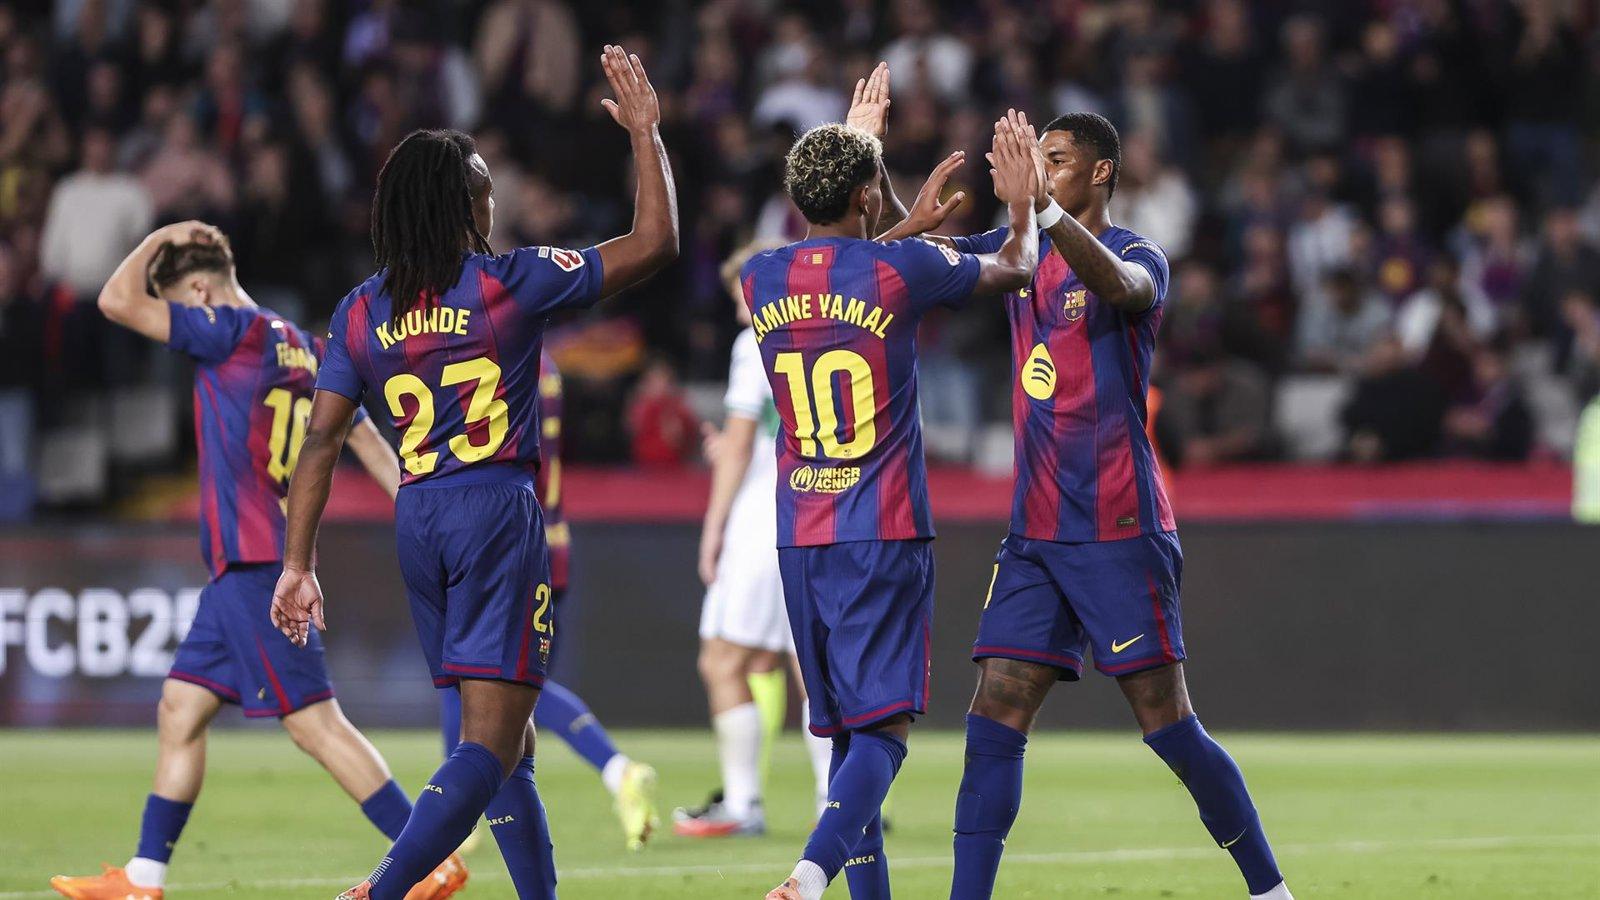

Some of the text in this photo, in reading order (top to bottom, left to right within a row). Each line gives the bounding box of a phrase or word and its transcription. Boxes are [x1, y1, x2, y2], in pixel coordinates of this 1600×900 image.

[375, 307, 471, 350] KOUNDE
[818, 294, 895, 339] YAMAL
[385, 356, 510, 476] 23
[774, 350, 876, 459] 10
[818, 467, 861, 478] UNHCR
